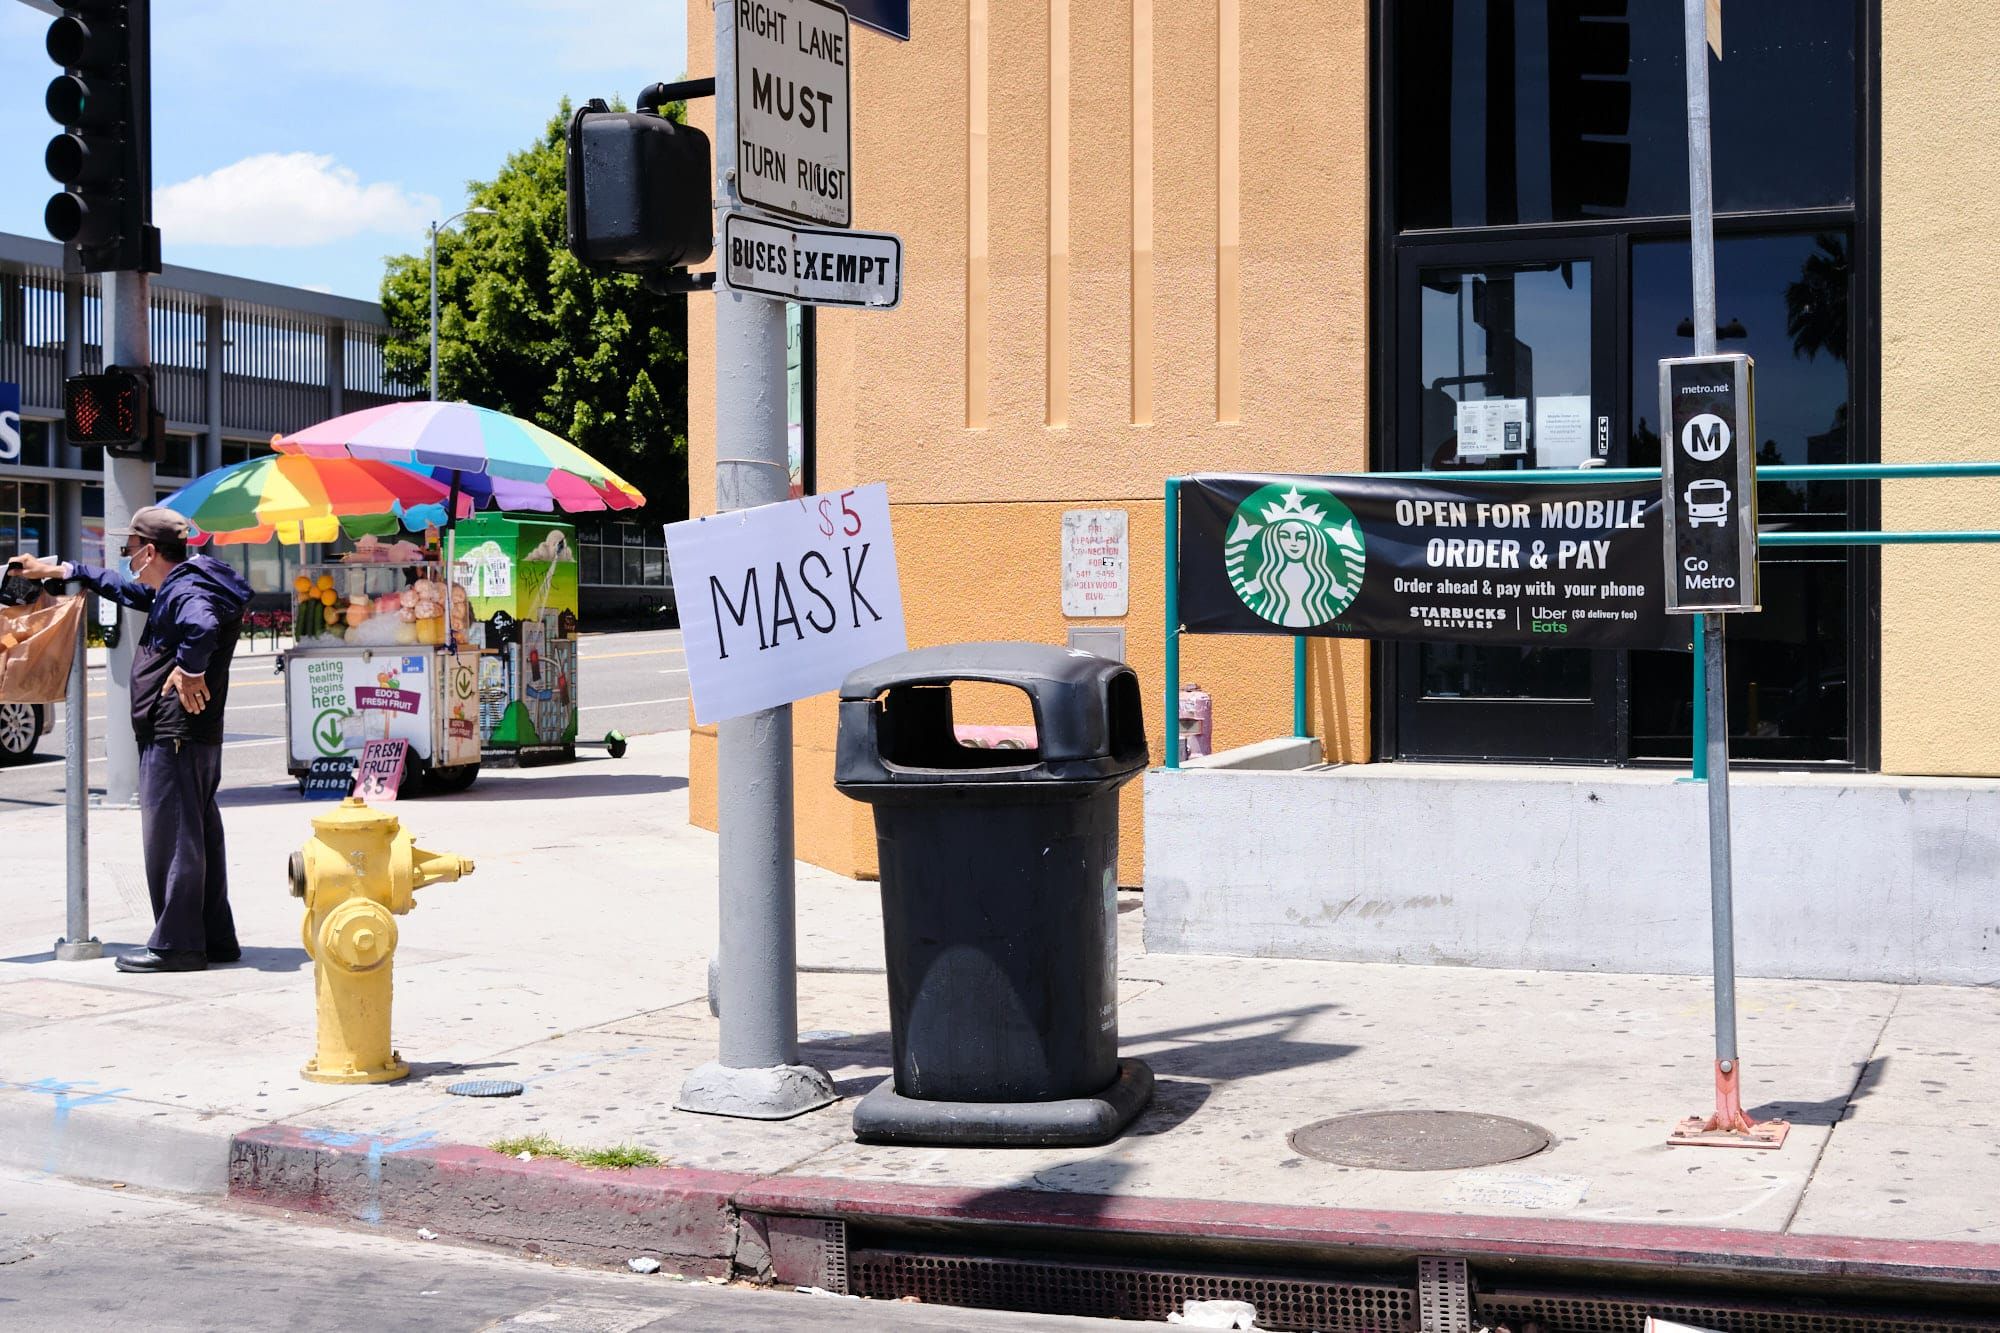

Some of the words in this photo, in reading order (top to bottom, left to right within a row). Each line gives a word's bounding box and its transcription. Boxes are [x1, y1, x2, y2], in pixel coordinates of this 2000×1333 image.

[740, 0, 787, 44] RIGHT
[798, 21, 844, 66] LANE
[752, 67, 832, 133] MUST
[742, 140, 786, 184] TURN
[732, 237, 786, 275] BUSES
[794, 250, 890, 285] EXEMPT
[1682, 384, 1729, 394] metro.net
[818, 490, 862, 540] $5
[1396, 500, 1466, 528] OPEN
[1476, 503, 1530, 528] FOR
[1541, 500, 1646, 529] MOBILE
[1426, 538, 1520, 569] ORDER
[1529, 540, 1548, 570] &
[1558, 540, 1611, 570] PAY
[1684, 556, 1708, 572] Go
[1394, 577, 1432, 594] Order
[1437, 579, 1478, 596] ahead
[1482, 580, 1492, 595] &
[1496, 583, 1521, 599] pay
[1526, 582, 1555, 596] with
[1564, 584, 1596, 599] your
[1601, 582, 1645, 599] phone
[1685, 574, 1736, 590] Metro
[710, 543, 882, 659] MASK
[1410, 606, 1506, 620] STARBUCKS
[1532, 606, 1566, 620] Uber
[1588, 610, 1619, 620] delivery
[1621, 610, 1638, 620] fee)
[1424, 620, 1494, 630] DELIVERS
[1532, 621, 1568, 633] Eats
[308, 660, 343, 674] eating
[310, 672, 344, 684] healthy
[312, 684, 344, 696] begins
[375, 688, 400, 699] EDO'S
[312, 694, 346, 708] here
[362, 698, 388, 708] FRESH
[389, 700, 414, 711] FRUIT
[366, 742, 404, 758] FRESH
[312, 762, 354, 772] COCOS
[362, 758, 400, 774] FRUIT
[362, 775, 387, 795] $5
